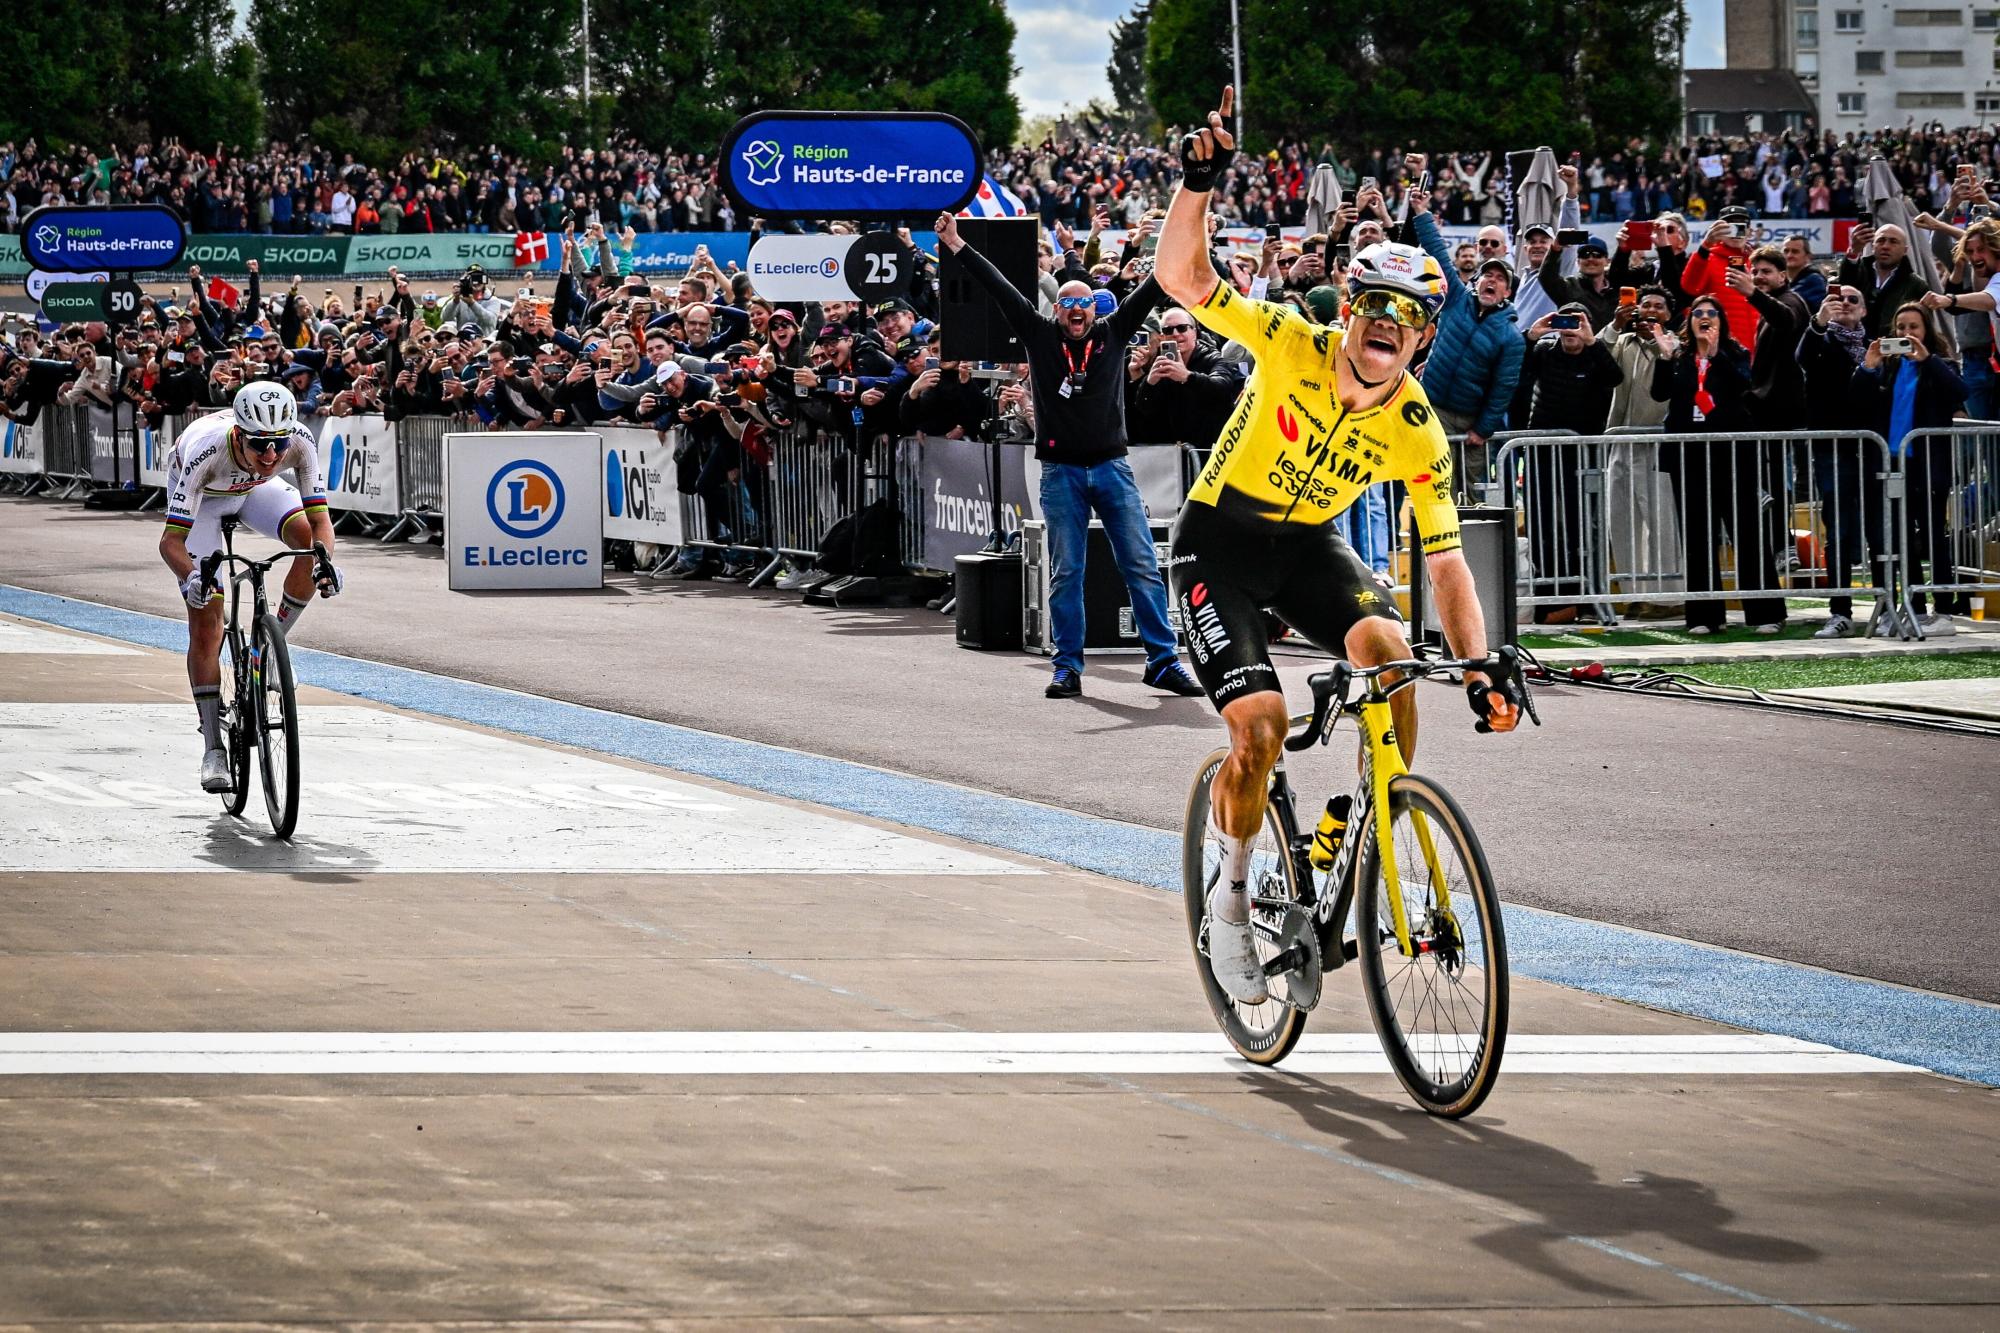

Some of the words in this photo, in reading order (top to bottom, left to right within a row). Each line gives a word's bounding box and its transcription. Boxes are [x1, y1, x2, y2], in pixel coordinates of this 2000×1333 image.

[792, 144, 848, 162] Région
[793, 165, 964, 184] Hauts-de-France
[67, 226, 102, 238] Région
[67, 239, 174, 251] Hauts-de-France
[183, 245, 241, 263] KODA
[456, 244, 516, 258] SKOD
[754, 261, 818, 276] E.Leclerc
[865, 253, 897, 283] 25
[1381, 262, 1398, 270] Red
[1399, 264, 1413, 274] Bull
[111, 291, 135, 311] 50
[1300, 379, 1321, 391] nimbl
[1204, 391, 1256, 488] Rabobank
[190, 445, 217, 470] Analog
[342, 433, 368, 495] ici
[1305, 434, 1373, 486] VISMA
[1275, 450, 1339, 497] lease
[622, 449, 650, 521] ici
[464, 546, 588, 567] E.Leclerc
[1195, 602, 1232, 655] VISMA
[1223, 663, 1273, 680] cervélo
[1214, 676, 1248, 700] nimbl
[1323, 699, 1343, 736] SRAM
